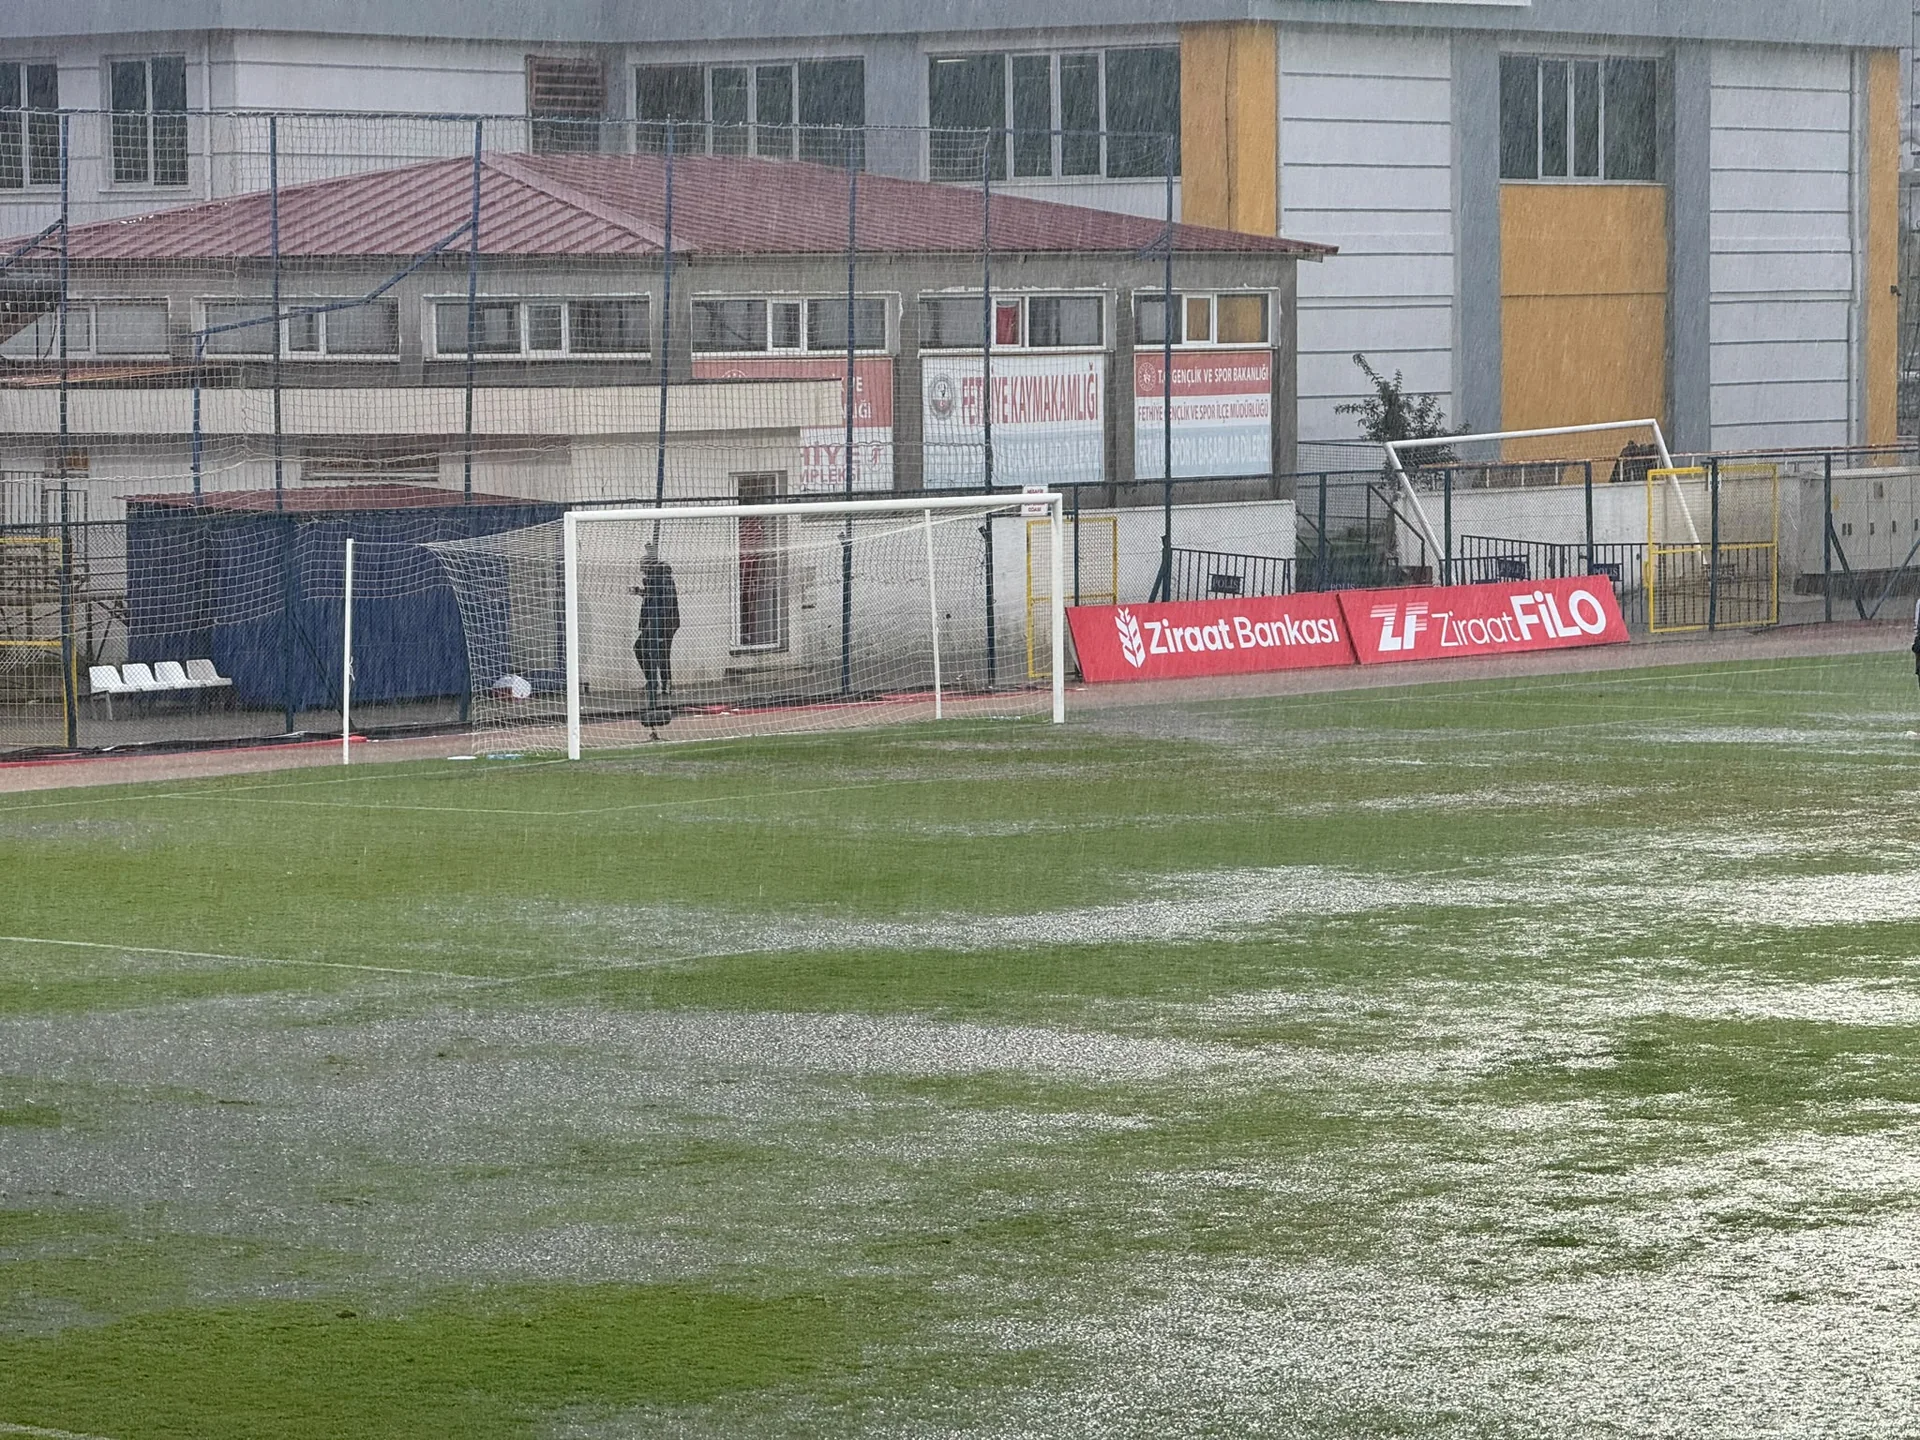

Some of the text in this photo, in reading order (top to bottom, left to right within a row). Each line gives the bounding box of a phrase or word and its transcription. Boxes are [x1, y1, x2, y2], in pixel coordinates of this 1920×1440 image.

[1172, 366, 1201, 388] GENÇLİK
[1203, 368, 1213, 383] VE
[1214, 367, 1232, 383] SPOR
[1233, 363, 1269, 382] BAKANLIĞI
[961, 366, 1008, 425] FETİYE
[1138, 399, 1269, 425] FETHİYE ENÇLİK VE SPOR İLÇE MÜDÜRLÜĞÜ
[1143, 613, 1340, 655] Ziraat Bankası
